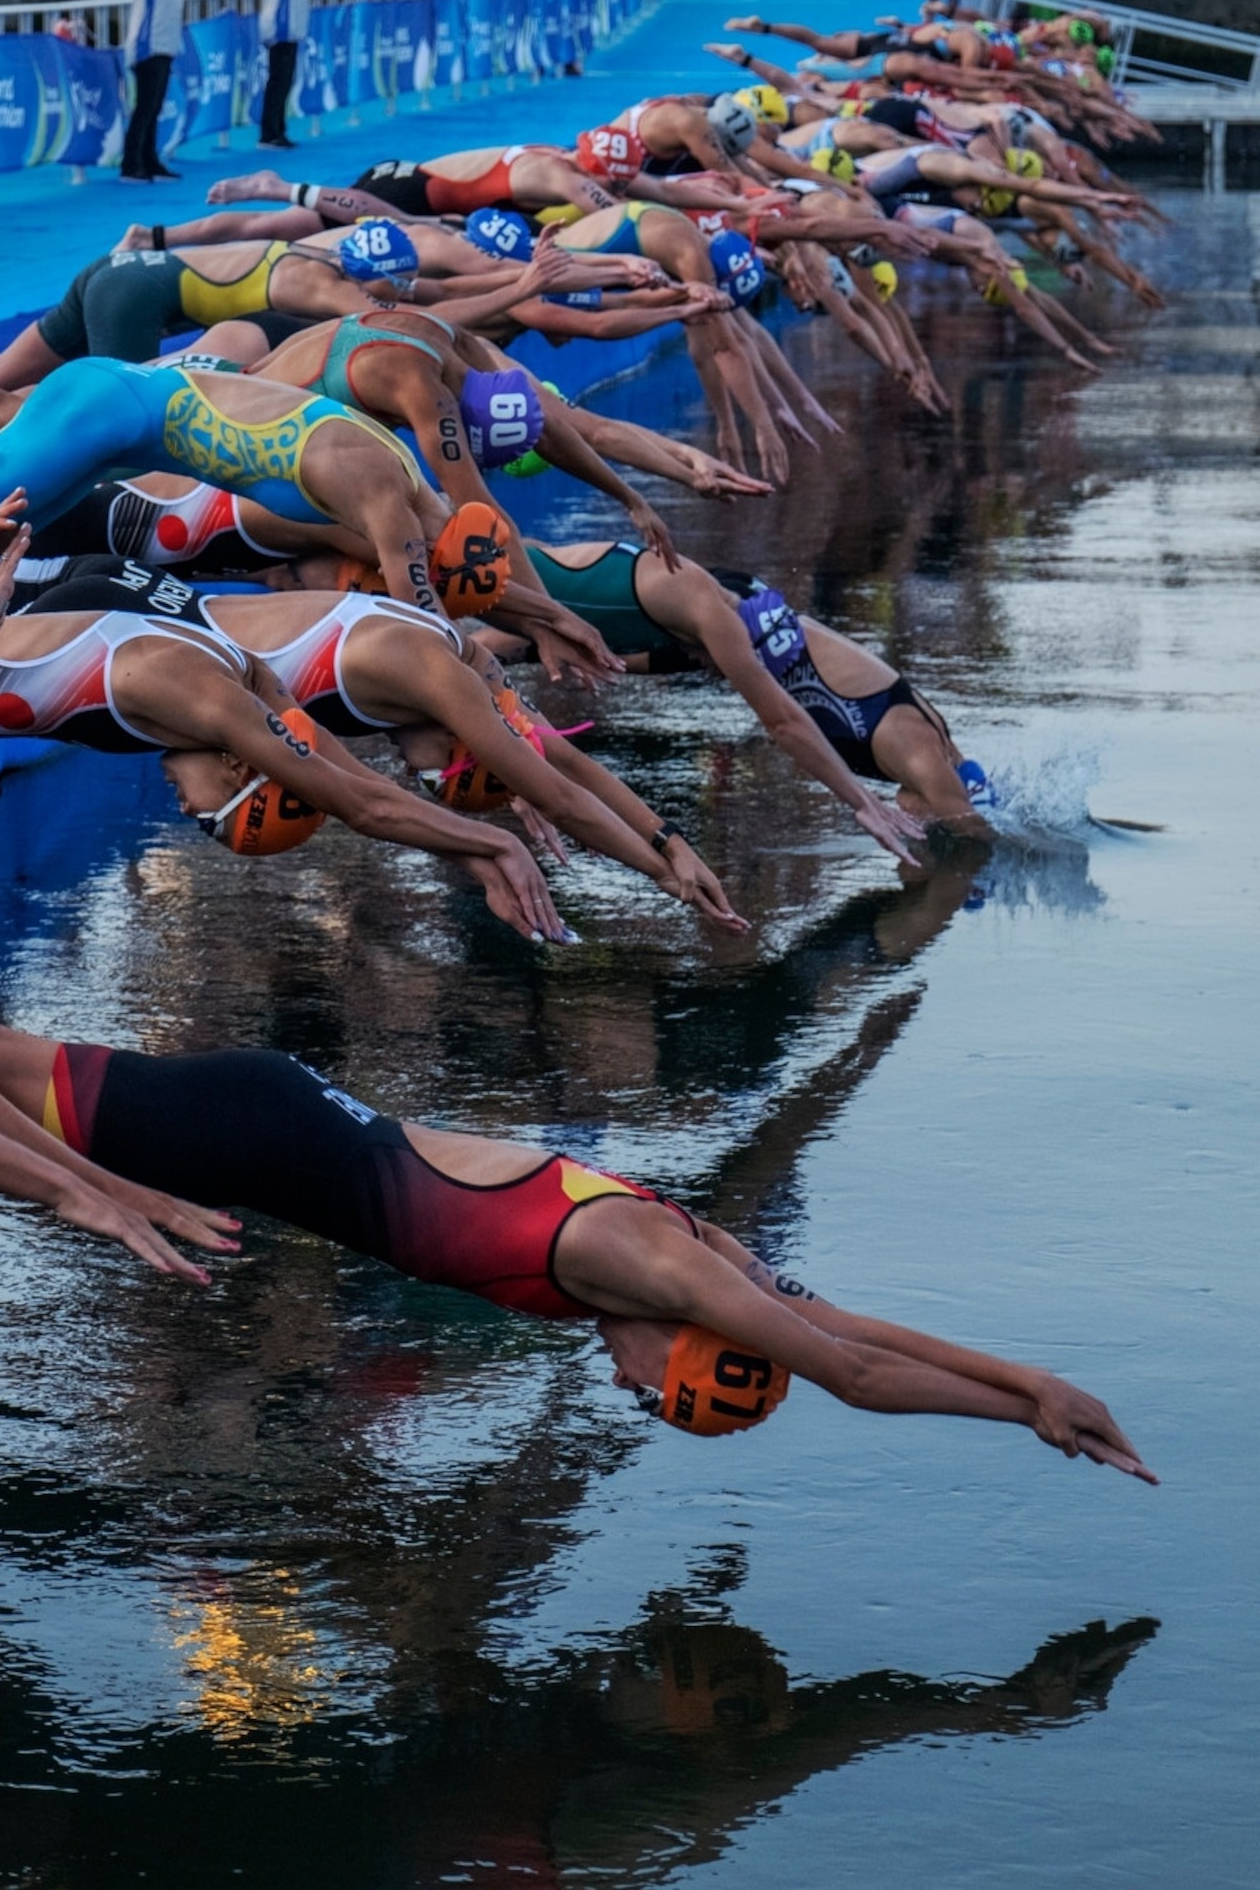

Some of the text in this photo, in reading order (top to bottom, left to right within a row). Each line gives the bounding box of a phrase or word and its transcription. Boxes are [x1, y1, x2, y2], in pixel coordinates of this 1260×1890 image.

[592, 131, 628, 160] 29
[352, 226, 392, 259] 38
[479, 215, 522, 254] 35
[439, 418, 462, 462] 60
[489, 392, 528, 447] 60
[408, 562, 435, 610] 62
[710, 1350, 772, 1420] 67
